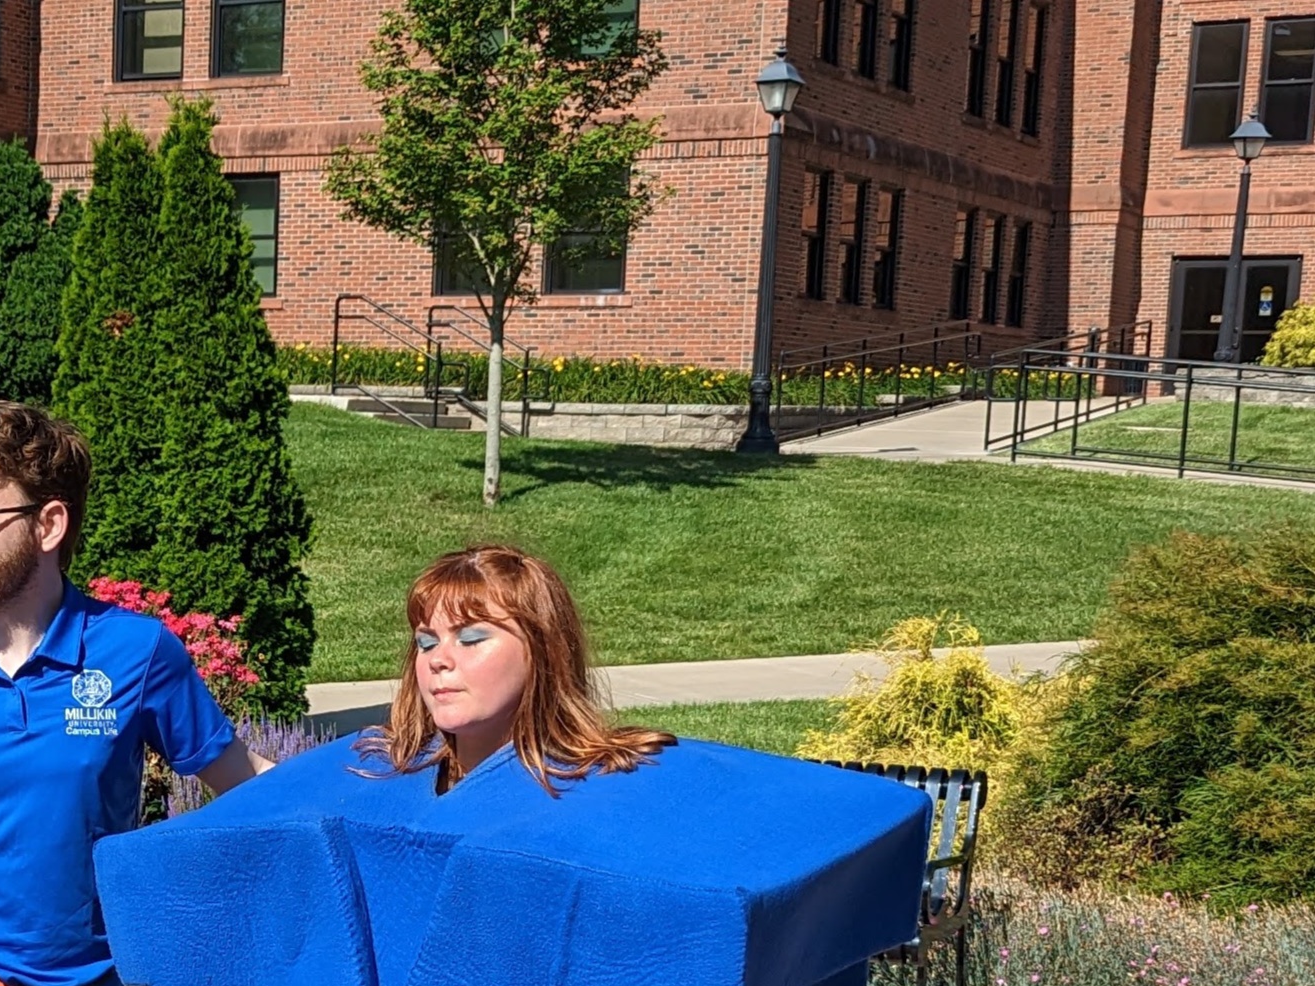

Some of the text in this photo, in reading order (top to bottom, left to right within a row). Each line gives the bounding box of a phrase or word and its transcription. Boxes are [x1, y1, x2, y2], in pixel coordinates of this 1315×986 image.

[65, 708, 117, 720] MILLIKIN
[65, 726, 119, 738] Campus Life
